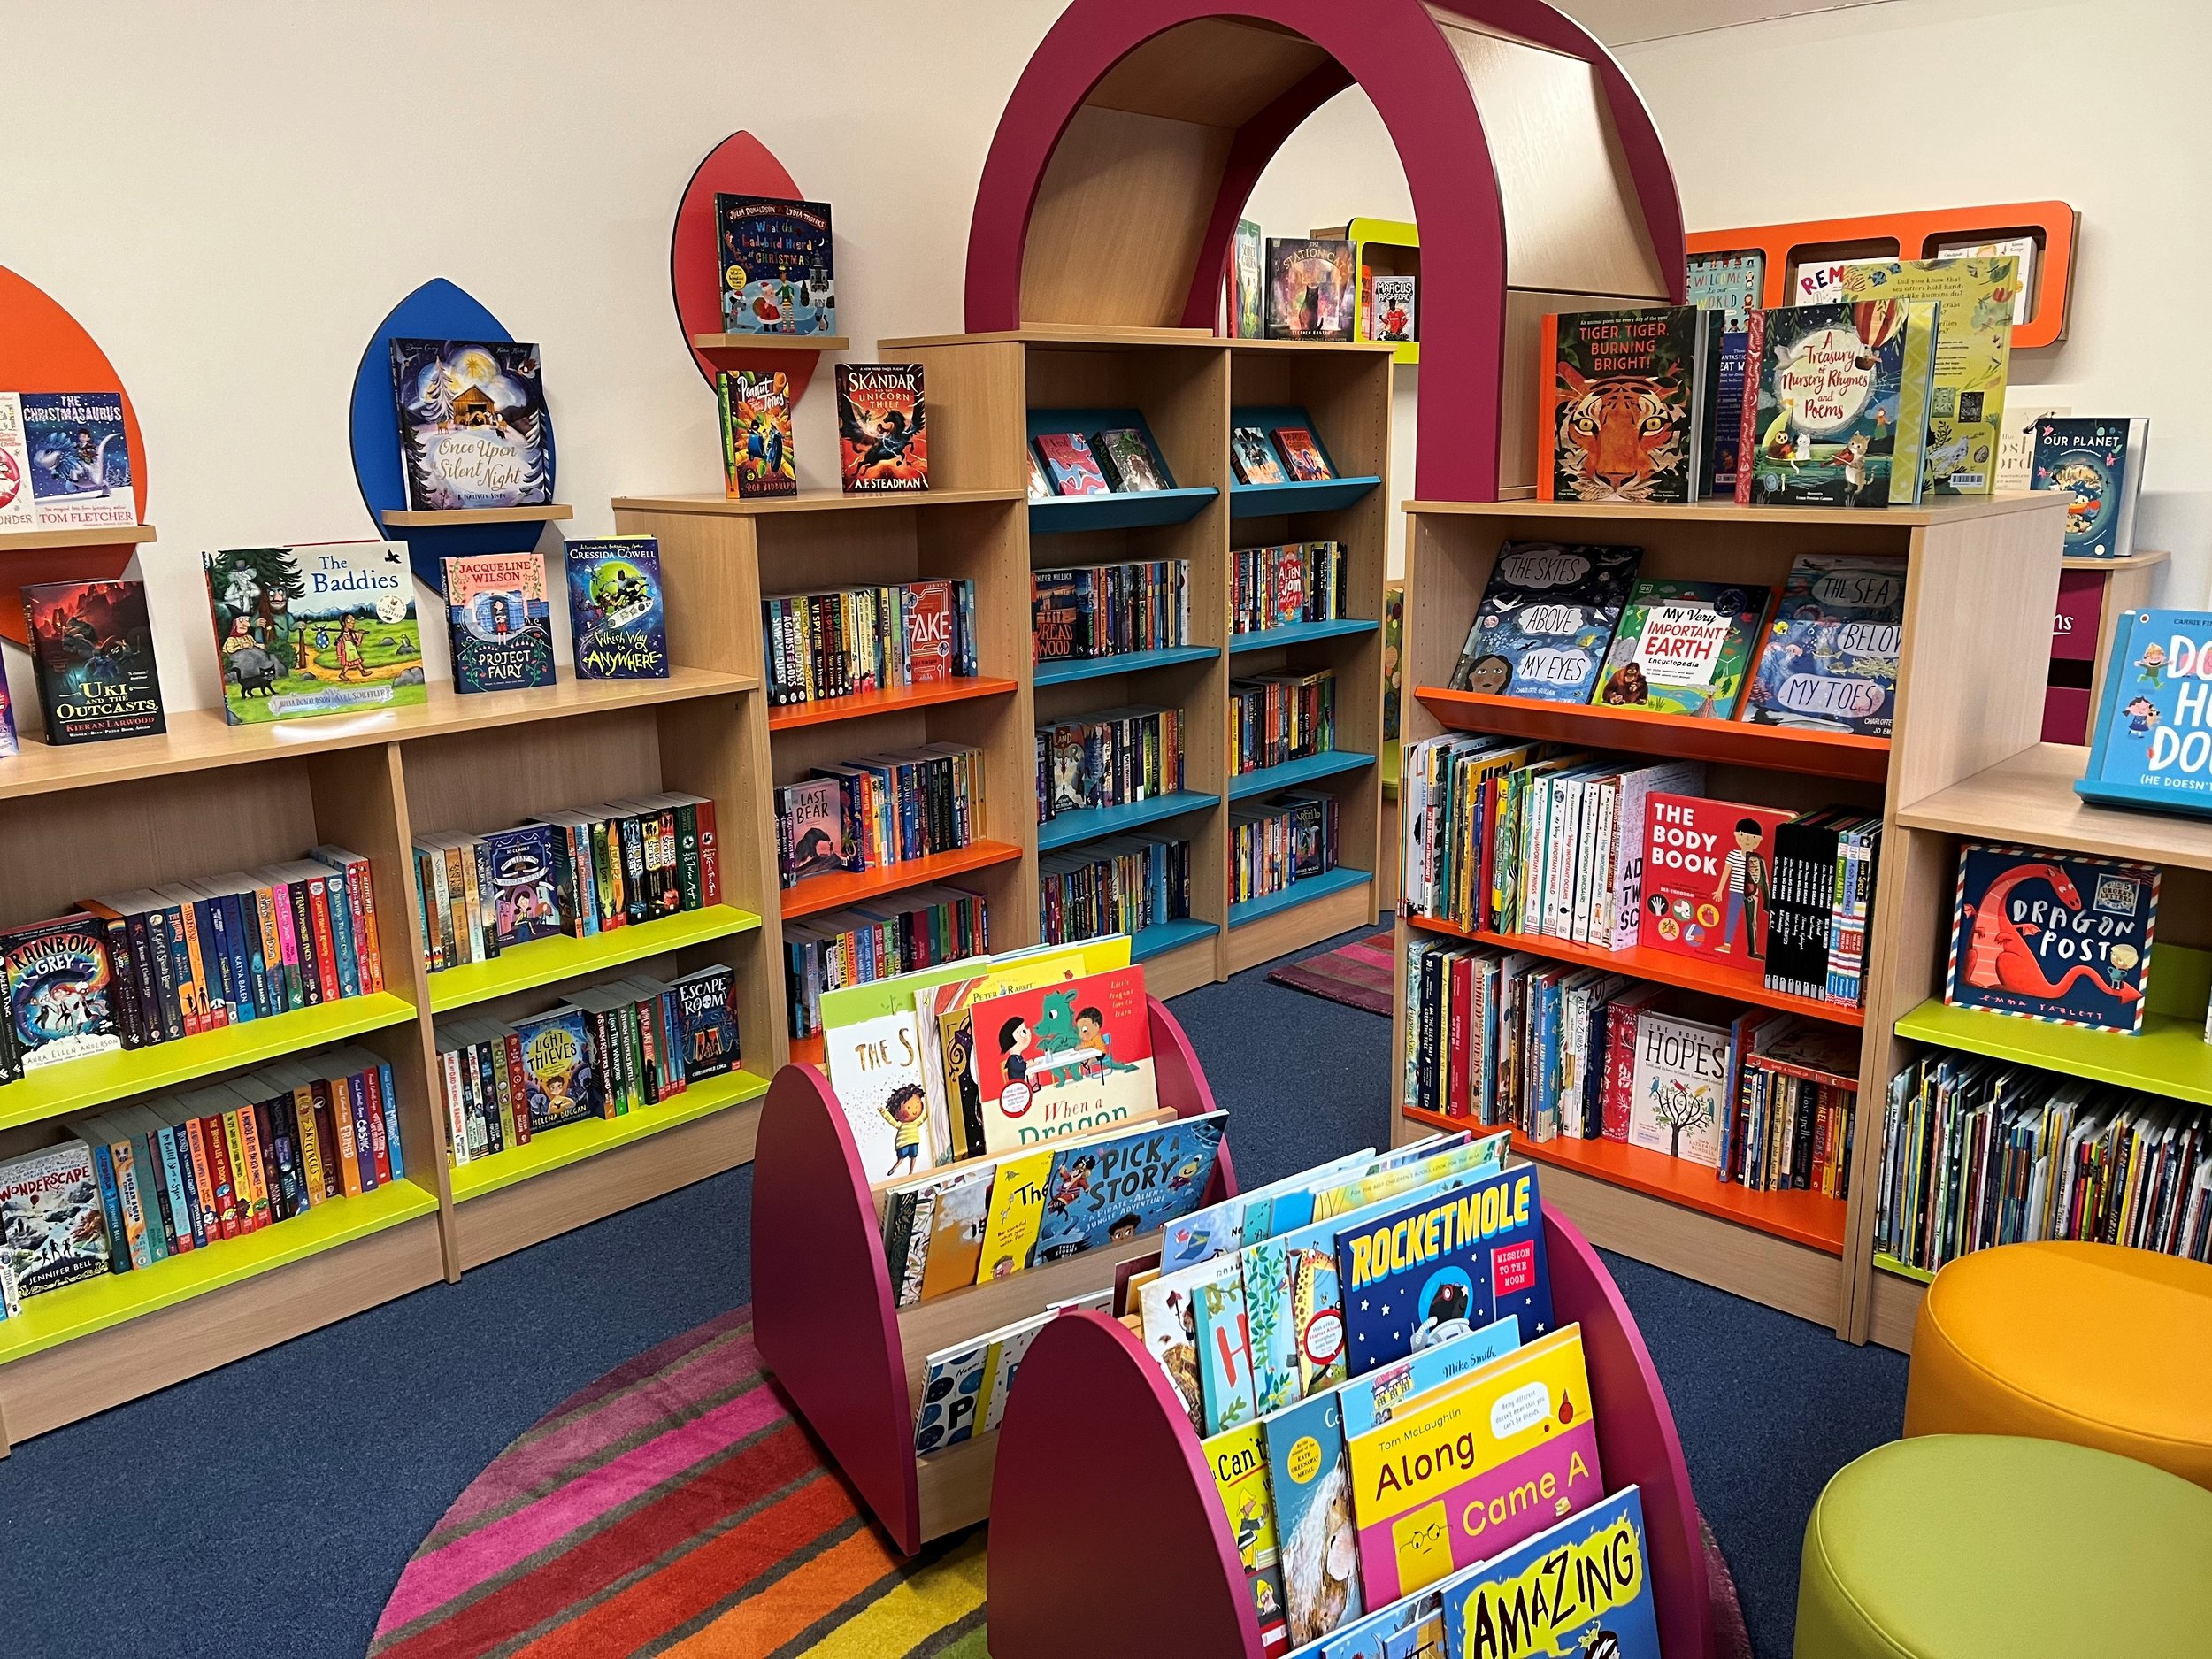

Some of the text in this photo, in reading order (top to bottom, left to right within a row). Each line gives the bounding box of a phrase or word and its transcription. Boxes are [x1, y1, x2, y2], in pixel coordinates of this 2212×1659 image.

[730, 208, 745, 219] JULIA
[746, 205, 776, 215] DONALDSON
[756, 221, 780, 232] What
[742, 234, 783, 251] Ladybird
[756, 254, 810, 265] CHRISTMAS
[1283, 249, 1325, 269] STATION
[1377, 282, 1412, 294] MARCUS
[1694, 270, 1741, 288] WELCOME
[1696, 294, 1738, 311] WORLD
[1591, 339, 1655, 355] BURNING
[1821, 330, 1832, 351] A
[1594, 356, 1650, 371] BRIGHT!
[1803, 345, 1855, 372] Treasury
[1818, 365, 1826, 374] of
[737, 376, 774, 402] Peanut
[848, 372, 918, 392] SKANDAR
[1782, 369, 1868, 396] Nursery Rhymes
[61, 396, 81, 407] THE
[858, 393, 910, 402] UNICORN
[1818, 391, 1833, 402] and
[23, 407, 122, 424] CHRISTMASAURUS
[1804, 399, 1844, 419] Poems
[438, 437, 517, 465] Once Upon
[2044, 436, 2119, 447] OUR PLANET
[437, 457, 482, 480] Silent
[478, 464, 521, 491] Night
[871, 478, 920, 488] STEADMAN
[39, 512, 133, 523] TOM FLETCHER
[319, 556, 347, 570] The
[570, 549, 656, 559] CRESSIDA COWELL
[458, 561, 531, 573] JACQUELINE
[472, 572, 520, 582] WILSON
[1279, 565, 1301, 580] ALIEN
[1509, 557, 1580, 582] THE SKIES
[311, 569, 399, 593] Baddies
[1823, 577, 1891, 605] THE SEA
[1525, 607, 1575, 633] ABOVE
[1663, 608, 1717, 625] My Very
[908, 611, 949, 643] FAKE
[1647, 621, 1723, 640] IMPORTANT
[594, 630, 648, 649] Which Way
[1038, 640, 1071, 657] WOOD
[1645, 636, 1713, 660] EARTH
[478, 649, 530, 665] PROJECT
[582, 650, 663, 676] ANYWHERE
[1648, 658, 1699, 668] Encyclopedia
[488, 664, 523, 679] FAIRY
[1522, 655, 1586, 681] MY EYES
[1790, 678, 1877, 711] MY TOES
[56, 699, 158, 719] OUTCASTS
[66, 717, 155, 733] KIERAN LARWOOD
[800, 789, 827, 807] LAST
[796, 803, 829, 825] BEAR
[1654, 803, 1694, 826] THE
[1653, 825, 1717, 852] BODY
[1651, 847, 1717, 876] BOOK
[2101, 893, 2132, 902] LETTERS
[2012, 899, 2136, 937] DRAGON
[9, 935, 98, 971] RAINBOW
[2039, 930, 2111, 963] POST
[35, 954, 75, 974] GREY
[234, 956, 248, 1002] KATYA BALEN
[680, 977, 726, 1001] ESCAPE
[973, 982, 1033, 1002] PETER RABBIT
[1649, 1023, 1669, 1033] THE
[51, 1039, 118, 1058] ELLEN ANDERSON
[534, 1033, 563, 1053] LIGHT
[527, 1042, 578, 1071] THIEVES
[855, 1041, 893, 1072] THE
[1646, 1030, 1725, 1079] HOPES
[532, 1104, 588, 1127] HELENA DUGGAN
[1045, 1098, 1102, 1122] When a
[341, 1124, 354, 1159] FRAMED
[357, 1119, 369, 1152] COSMIC
[1100, 1137, 1179, 1180] PICK A
[0, 1166, 90, 1202] WONDERSCAPE
[1087, 1156, 1180, 1212] STORY
[1086, 1194, 1167, 1232] JUNGLE ADVENTURE
[1096, 1202, 1127, 1220] PIRATE
[1007, 1219, 1026, 1232] careful
[1348, 1175, 1532, 1294] ROCKETMOLE
[1496, 1247, 1532, 1266] MISSION
[28, 1260, 92, 1285] JENNIFER BELL
[1499, 1262, 1527, 1275] TO THE
[1504, 1273, 1525, 1286] MOON
[1442, 1346, 1497, 1379] Mike Smith
[1378, 1408, 1462, 1452] Tom McLaughlin
[1376, 1432, 1475, 1501] Along
[1462, 1450, 1590, 1537] Came A
[1473, 1526, 1637, 1659] AMAZING
